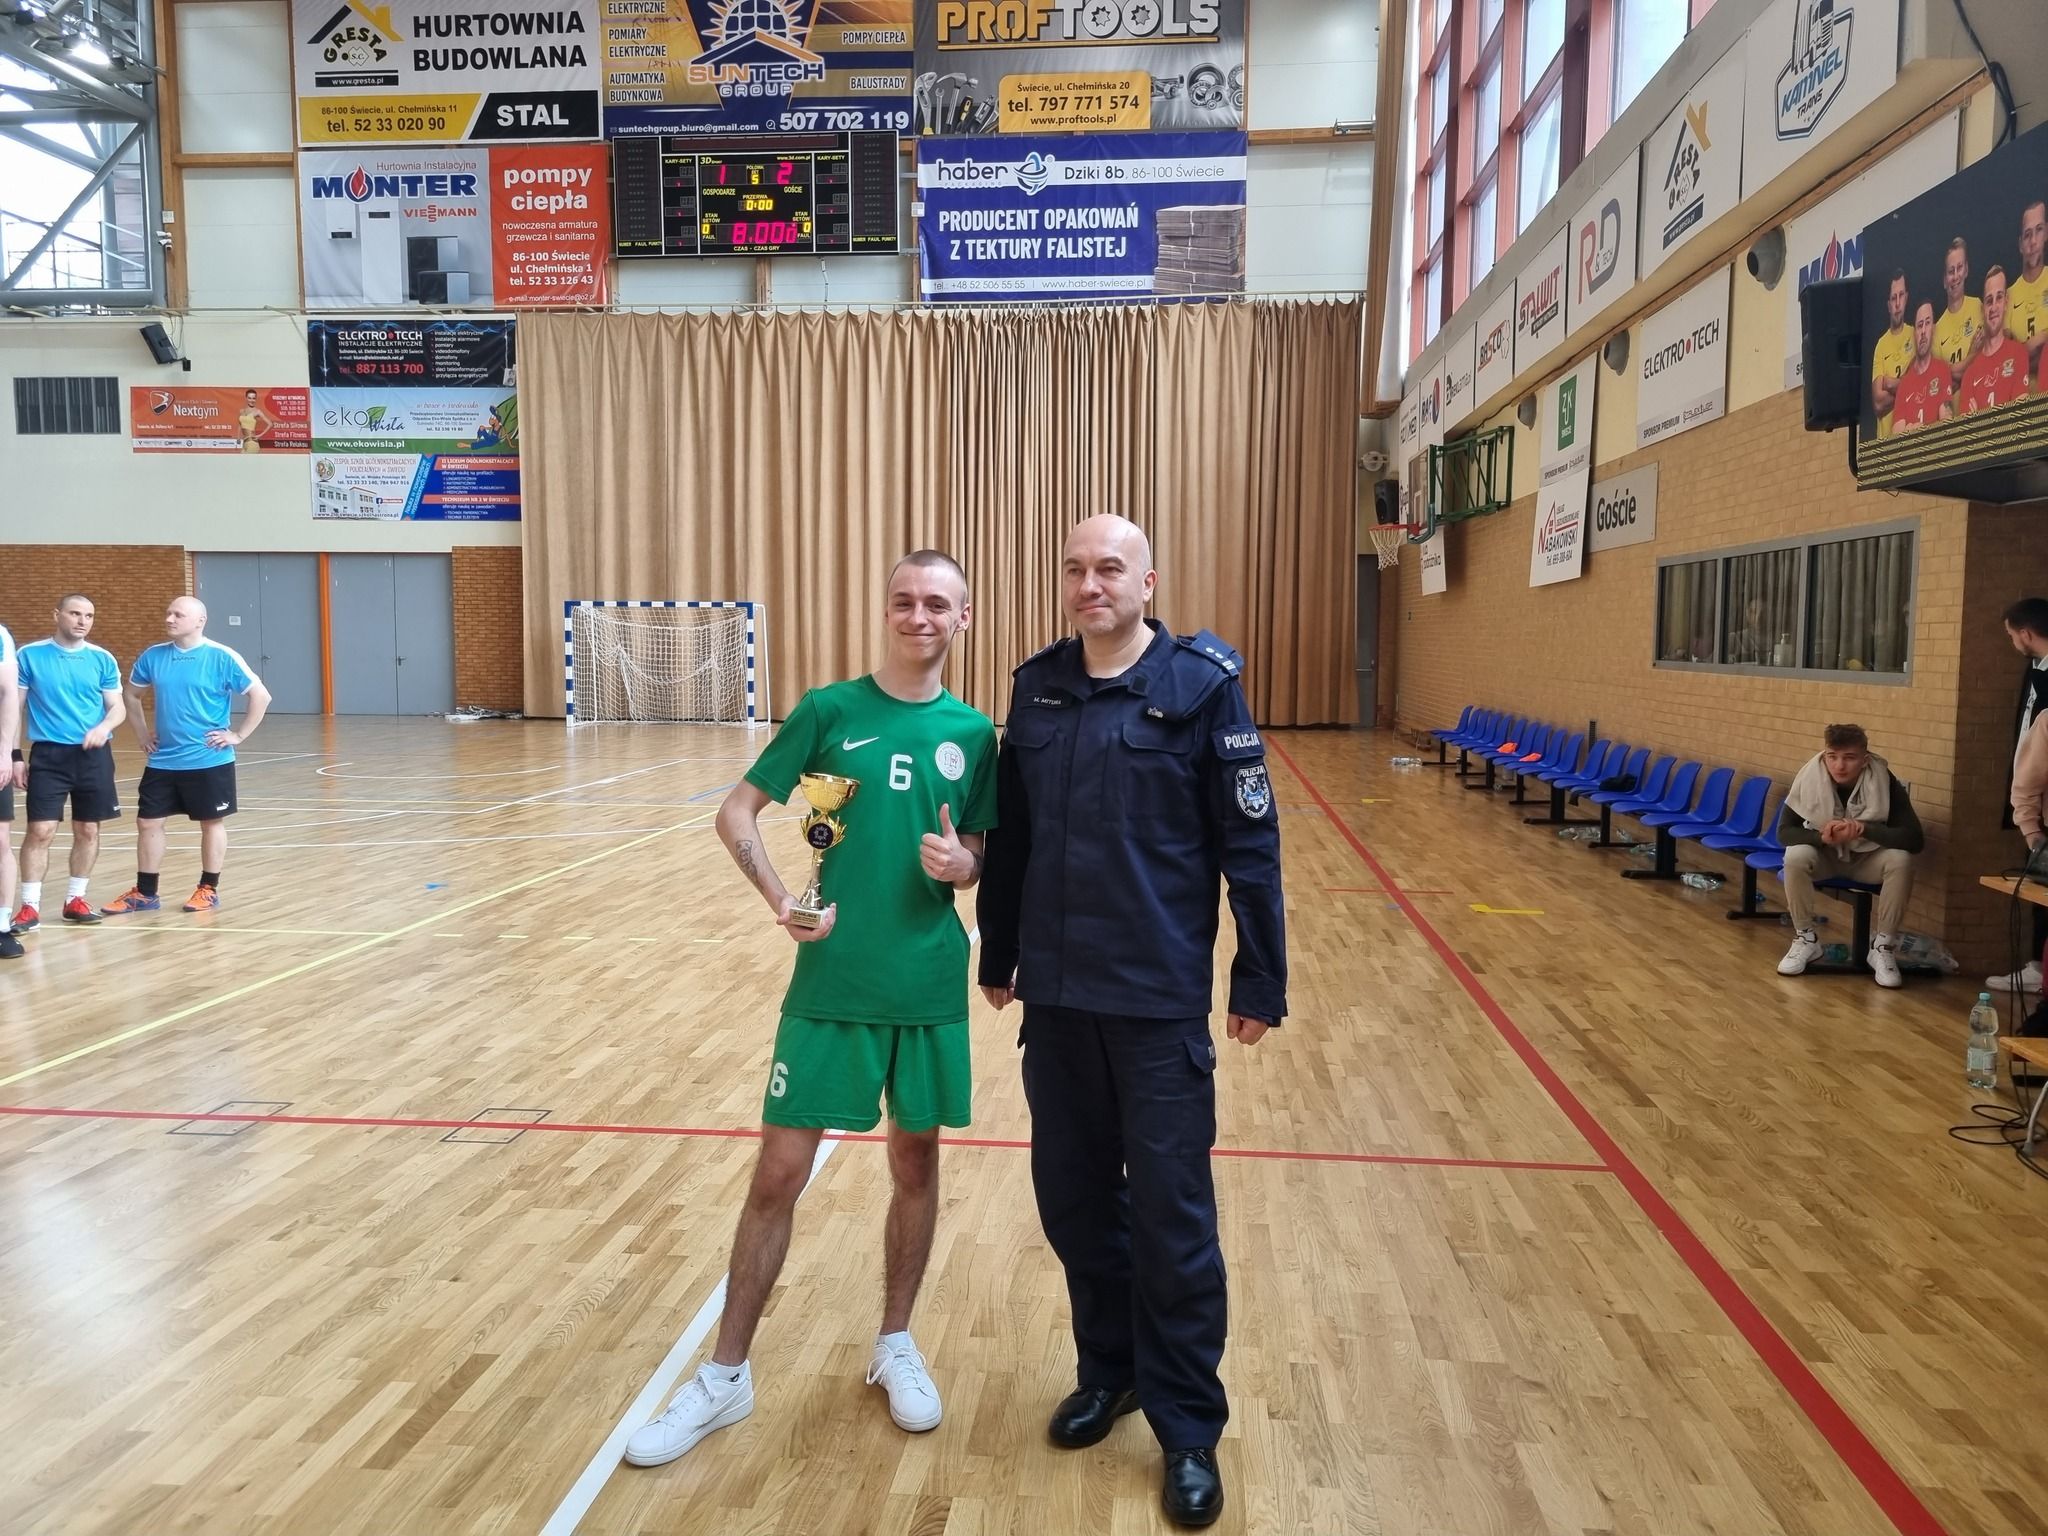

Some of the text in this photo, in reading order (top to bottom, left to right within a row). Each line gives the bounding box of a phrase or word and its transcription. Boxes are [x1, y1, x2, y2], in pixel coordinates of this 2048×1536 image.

[608, 2, 665, 14] ELEKTRYCZNE
[413, 10, 585, 38] HURTOWNIA
[937, 0, 1220, 42] PROFTOOLS
[609, 29, 647, 40] POMIARY
[843, 31, 906, 43] POMPY CIEPŁA
[323, 26, 387, 64] GRESTA
[609, 46, 666, 57] ELEKTRYCZNE
[413, 44, 587, 72] BUDOWLANA
[610, 73, 665, 84] AUTOMATYKA
[688, 63, 825, 84] SUNTECH
[331, 76, 384, 87] www.gresta.pl
[851, 77, 906, 89] BALUSTRADY
[1017, 81, 1130, 94] Świecie, ul. Chełmińska 20
[610, 89, 662, 102] BUDYNKOWA
[720, 83, 793, 97] GROUP
[321, 103, 457, 116] 86-100 Świecie, ul. Chełmińska 11
[1008, 94, 1139, 112] tel. 797 771 574
[497, 104, 569, 126] STAL
[780, 111, 909, 130] 507 702 119
[1030, 113, 1117, 126] www.proftools.pl
[327, 116, 446, 133] tel. 52 33 020 90
[618, 124, 759, 133] suntechgroup.biuro@gmail.com
[377, 160, 477, 171] Hurtownia Instalacyjna
[938, 158, 1008, 181] haber
[1064, 166, 1100, 180] Dziki
[1132, 165, 1173, 179] 86-100
[1176, 163, 1224, 178] Świecie
[504, 168, 592, 188] pompy
[720, 165, 726, 185] 1
[751, 174, 759, 185] 5
[777, 162, 793, 184] 2
[312, 170, 478, 203] MONTER
[511, 190, 588, 214] ciepła
[746, 199, 773, 211] 0:00
[403, 204, 477, 223] VIESSMANN
[939, 202, 1139, 232] PRODUCENT OPAKOWAŃ
[502, 220, 598, 230] nowoczesna armatura
[702, 224, 710, 234] 0
[803, 222, 811, 233] 0
[506, 233, 547, 243] grzewcza
[555, 232, 595, 241] sanitarna
[950, 236, 1127, 260] Z TEKTURY FALISTEJ
[512, 250, 590, 261] 86-100 Świecie
[510, 263, 592, 274] ul. Chełmińska 1
[510, 275, 594, 286] tel. 52 33 126 43
[951, 281, 967, 289] +48
[970, 281, 980, 289] 52
[983, 281, 1000, 289] 506
[1001, 281, 1012, 289] 55
[1014, 280, 1025, 289] 55
[1042, 278, 1146, 289] www.haber-swiecie.pl
[356, 364, 424, 374] 887 113 700
[173, 404, 218, 419] Nextgym
[323, 406, 369, 426] eko
[366, 416, 405, 434] Wisła
[327, 440, 405, 449] www.ekowisla.pl
[1596, 489, 1636, 532] Goście
[1224, 732, 1260, 750] POLICJA
[888, 754, 913, 791] 6
[1238, 764, 1266, 778] POLICJA
[769, 1062, 789, 1098] 6
